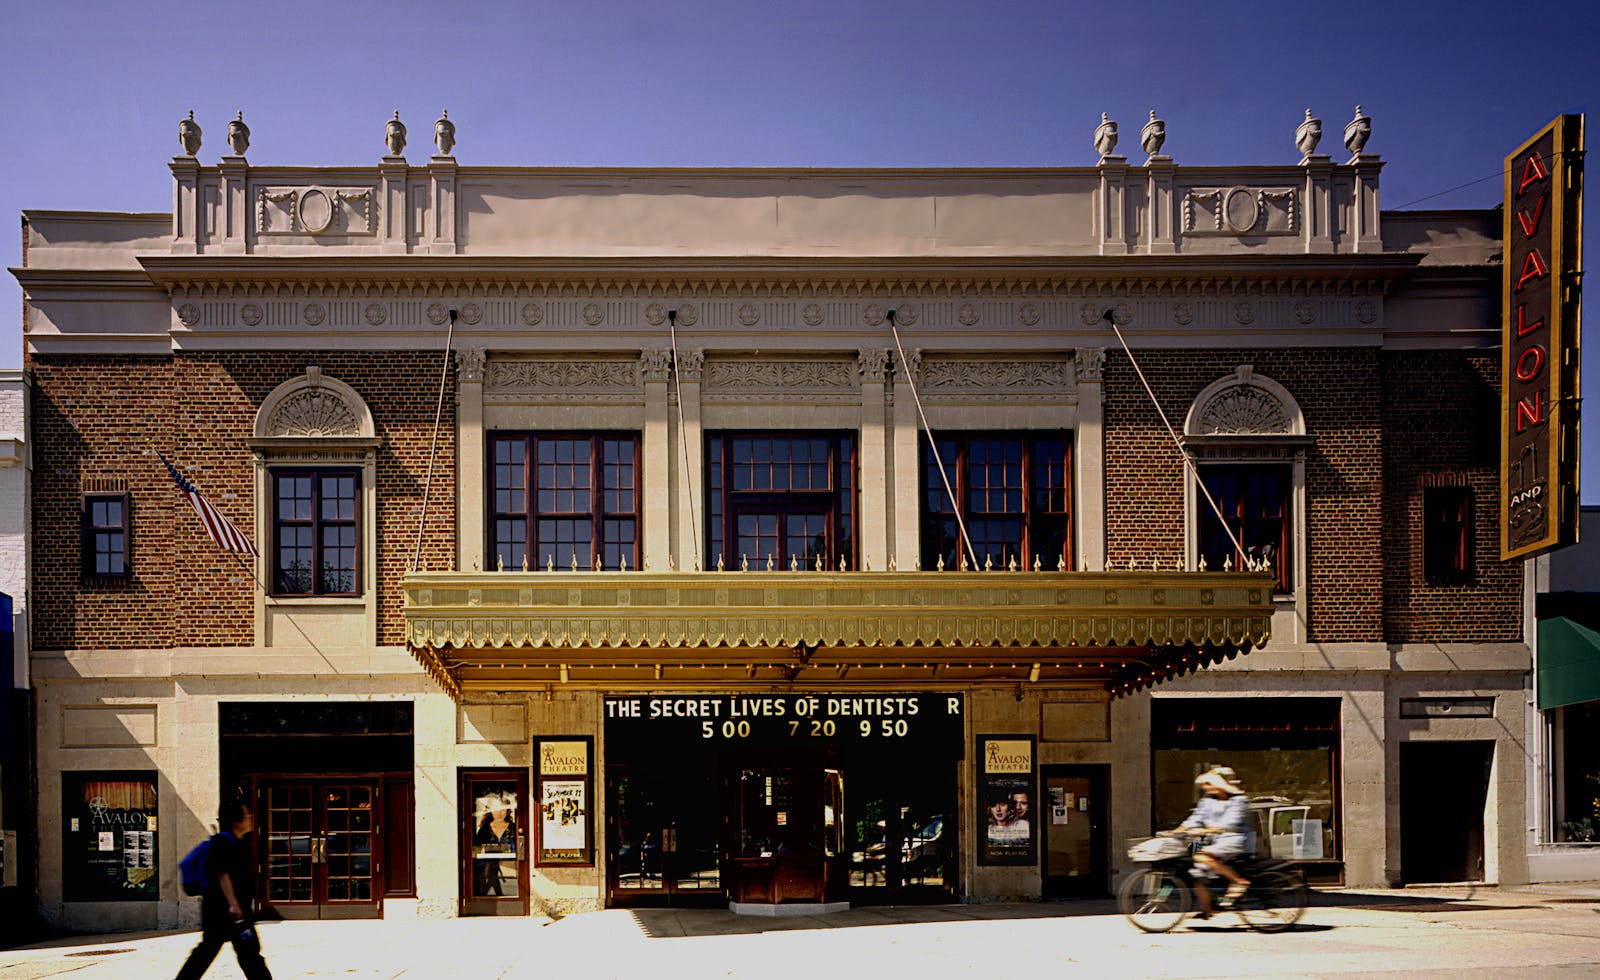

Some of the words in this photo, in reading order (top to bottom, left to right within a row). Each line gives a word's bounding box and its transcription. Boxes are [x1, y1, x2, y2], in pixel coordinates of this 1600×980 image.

[1515, 151, 1549, 433] AVALON
[1510, 485, 1541, 507] AND
[606, 700, 641, 717] THE
[650, 699, 722, 717] SECRET
[731, 699, 786, 716] LIVES
[795, 699, 820, 716] OF
[828, 698, 919, 715] DENTISTS
[947, 698, 960, 714] R
[702, 721, 714, 738] 5
[722, 720, 750, 738] 00
[788, 721, 800, 736] 7
[811, 720, 836, 736] 20
[859, 720, 871, 737] 9
[881, 719, 908, 737] 50
[543, 753, 585, 765] AVALON
[988, 752, 1029, 764] AVALON
